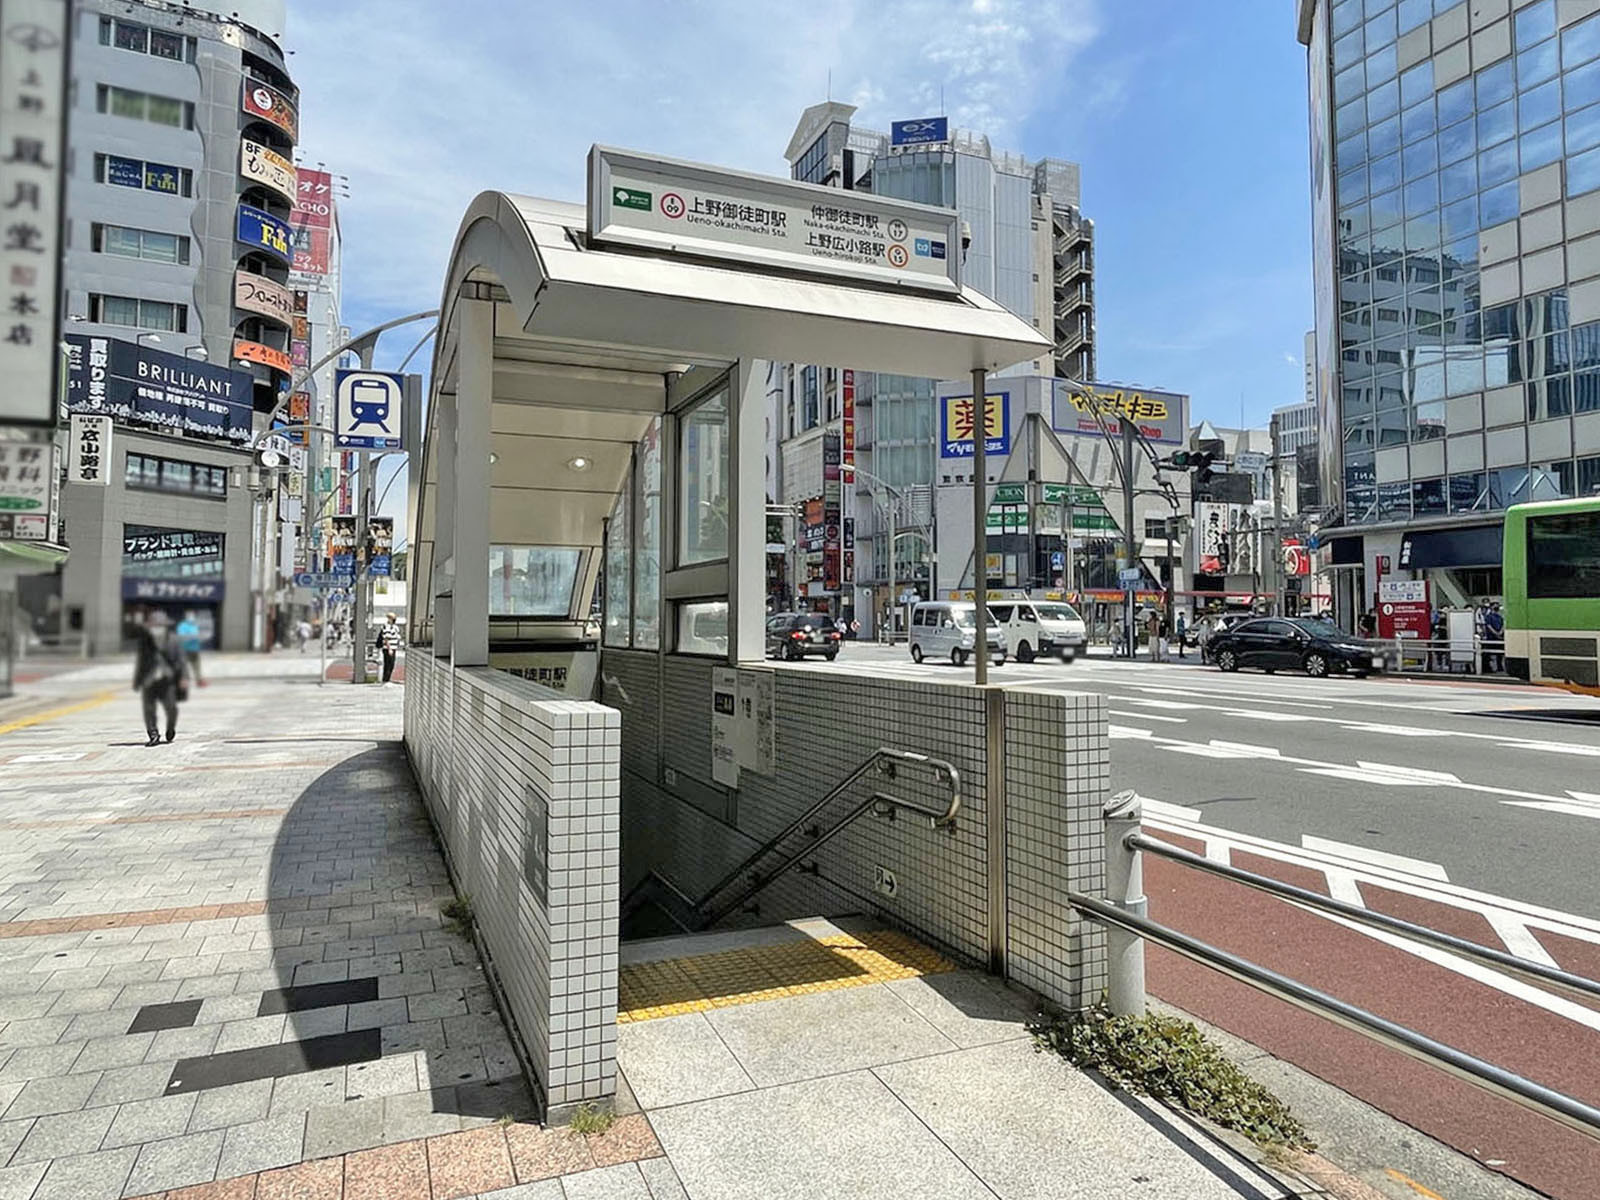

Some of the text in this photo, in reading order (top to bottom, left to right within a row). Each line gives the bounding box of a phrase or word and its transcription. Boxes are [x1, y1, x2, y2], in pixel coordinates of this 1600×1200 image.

[245, 142, 261, 155] 8F
[146, 172, 177, 191] Fun
[667, 204, 679, 214] 09
[689, 197, 787, 228] 上野御徒町駅
[811, 205, 879, 230] 仲御徒町駅
[687, 214, 788, 238] Ueno-okachimachi Sta.
[804, 219, 871, 237] Naka-okachimachi
[893, 230, 903, 238] 17
[261, 223, 288, 255] Fun
[805, 232, 886, 257] 上野広小路駅
[812, 249, 863, 264] Ueno-hirokoji
[894, 255, 903, 263] 15
[89, 339, 107, 409] 買取ります
[138, 361, 232, 397] BRILLIANT
[955, 399, 995, 439] 薬
[946, 440, 1004, 455] マツモヨシ
